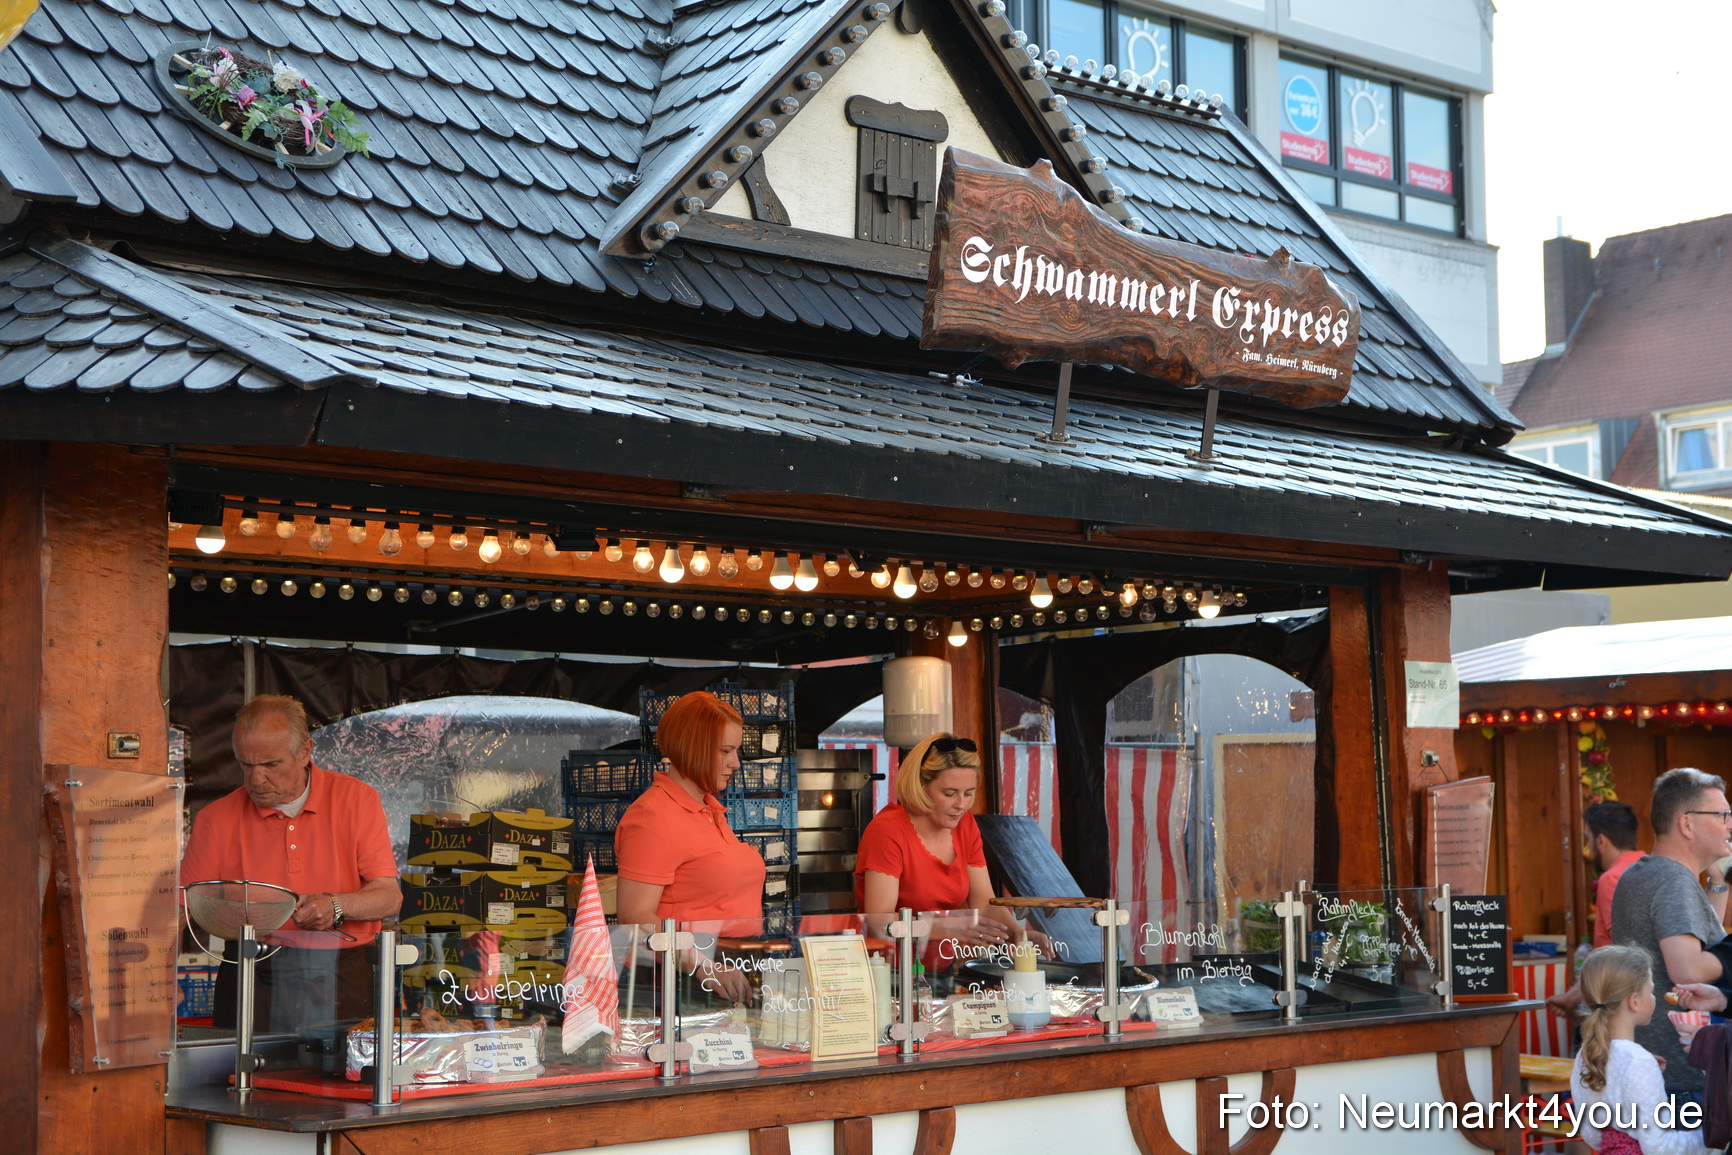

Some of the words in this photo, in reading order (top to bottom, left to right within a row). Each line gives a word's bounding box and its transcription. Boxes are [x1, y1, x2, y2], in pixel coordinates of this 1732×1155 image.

[960, 236, 1200, 323] Schwammerl
[1211, 286, 1350, 348] Express
[1242, 348, 1263, 362] Fam.
[1265, 353, 1299, 370] Heimerl,
[1302, 360, 1338, 379] Nürnberg
[1439, 680, 1448, 690] 65
[89, 795, 154, 808] Sortimentwahl
[429, 830, 467, 849] DAZA
[422, 891, 459, 911] DAZA
[504, 888, 536, 901] DAZA
[1318, 897, 1380, 923] Rahmfleck
[1453, 900, 1500, 916] Rahmfleck
[1140, 921, 1226, 955] Blumenkohl
[938, 938, 1042, 968] Champignons
[1049, 937, 1070, 958] im
[701, 951, 785, 992] gebackene
[1176, 958, 1195, 981] im
[1201, 957, 1255, 987] Bierteig
[1481, 978, 1488, 987] €
[759, 984, 837, 1014] Zucchini
[474, 1041, 523, 1051] Zwiebelringe
[704, 1038, 733, 1046] Zucchini
